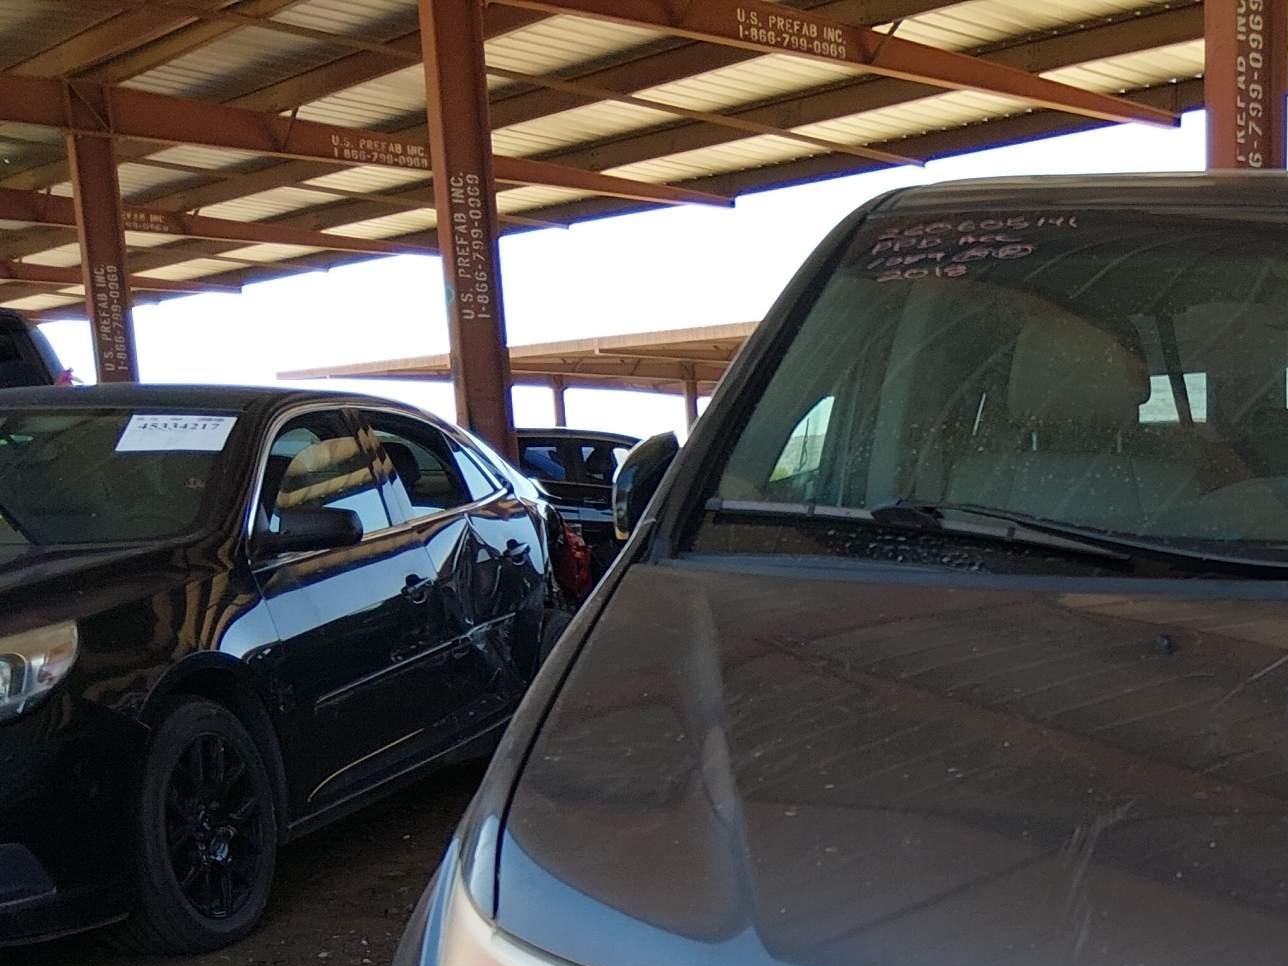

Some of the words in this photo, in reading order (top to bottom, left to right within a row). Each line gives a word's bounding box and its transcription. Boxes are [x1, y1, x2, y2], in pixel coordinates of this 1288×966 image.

[737, 7, 762, 27] U.S.
[768, 15, 818, 38] PREFAB
[823, 26, 847, 45] INC.
[738, 24, 847, 59] 1-866-799-0969
[359, 138, 402, 154] PREFAB
[450, 172, 466, 204] INC.
[453, 212, 472, 279] PREFAB
[466, 173, 491, 319] 1-866-799-0969
[97, 293, 113, 342] PREFAB
[460, 288, 476, 320] U.S.
